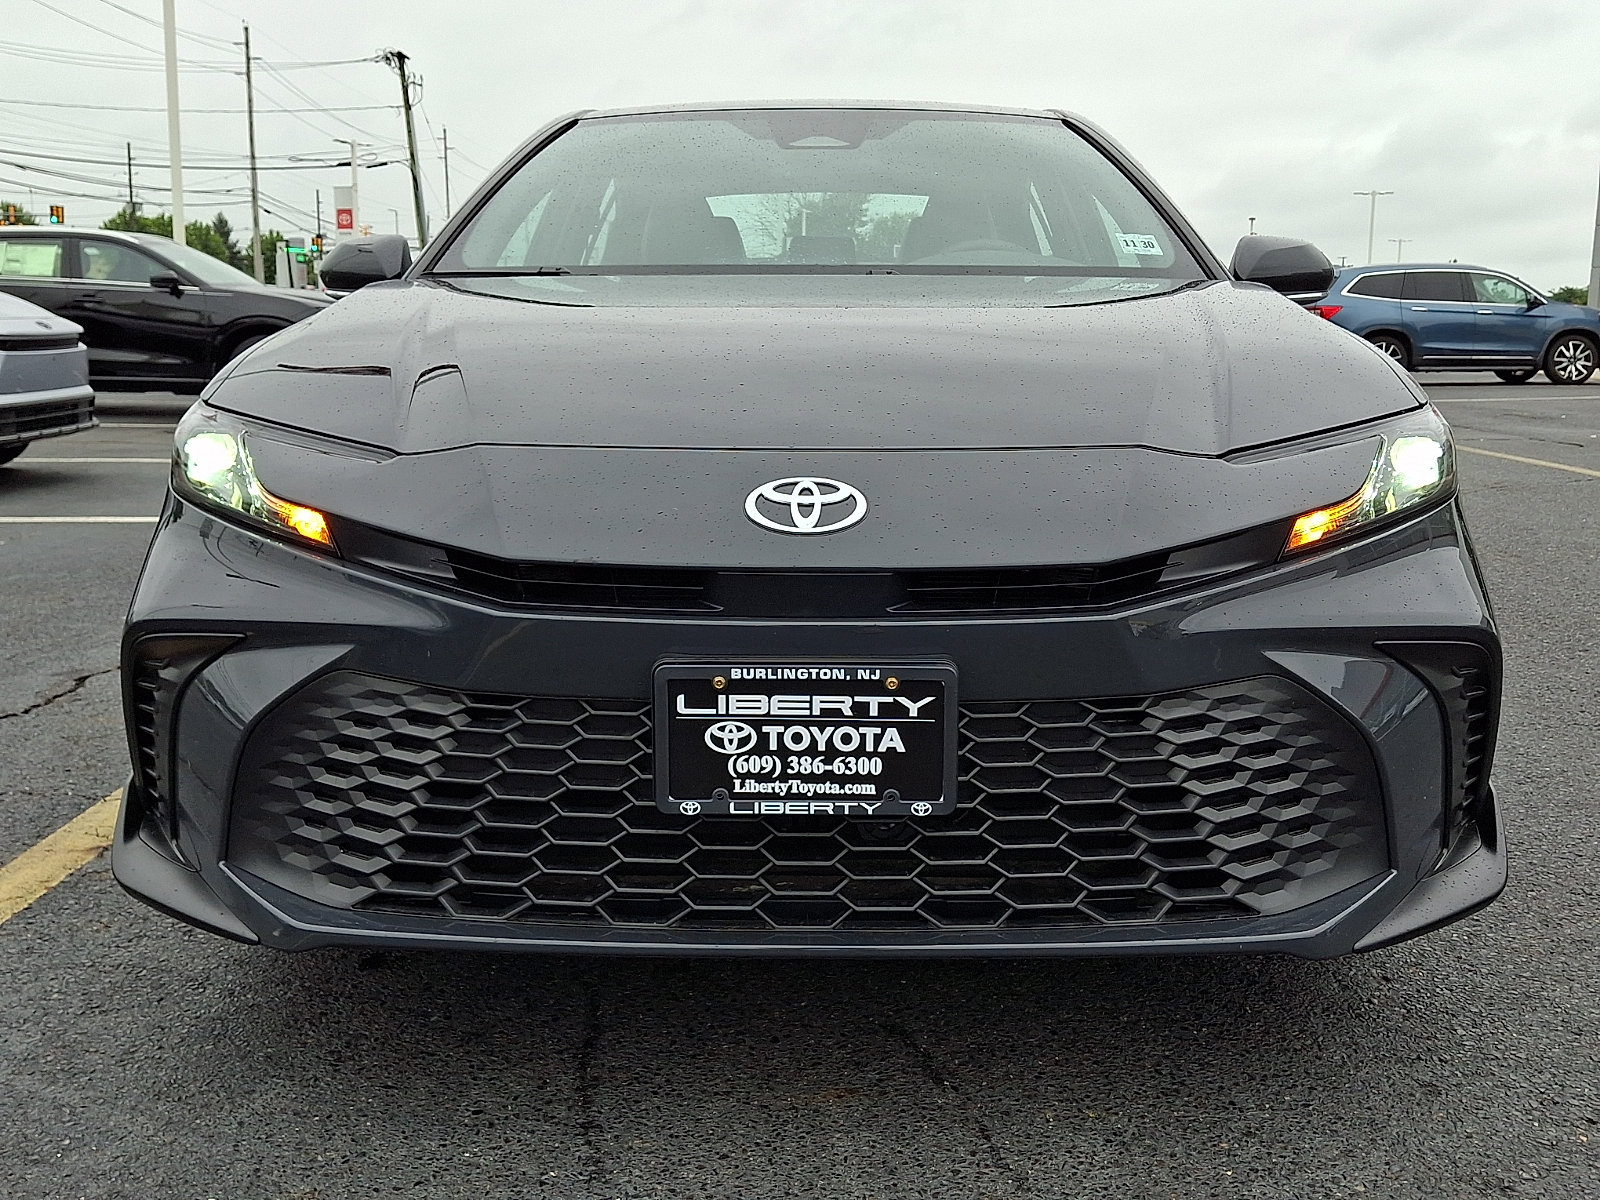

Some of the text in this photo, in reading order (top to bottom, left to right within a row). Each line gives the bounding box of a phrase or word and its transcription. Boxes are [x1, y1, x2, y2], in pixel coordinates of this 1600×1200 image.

[1122, 239, 1155, 249] 11 30
[730, 668, 881, 681] BURLINGTON, NJ
[676, 693, 936, 717] LIBERTY
[762, 725, 906, 753] TOYOTA
[727, 755, 883, 778] (609) 386-6300
[732, 779, 876, 796] LibertyToyota.com
[729, 801, 882, 815] LIBERTY
